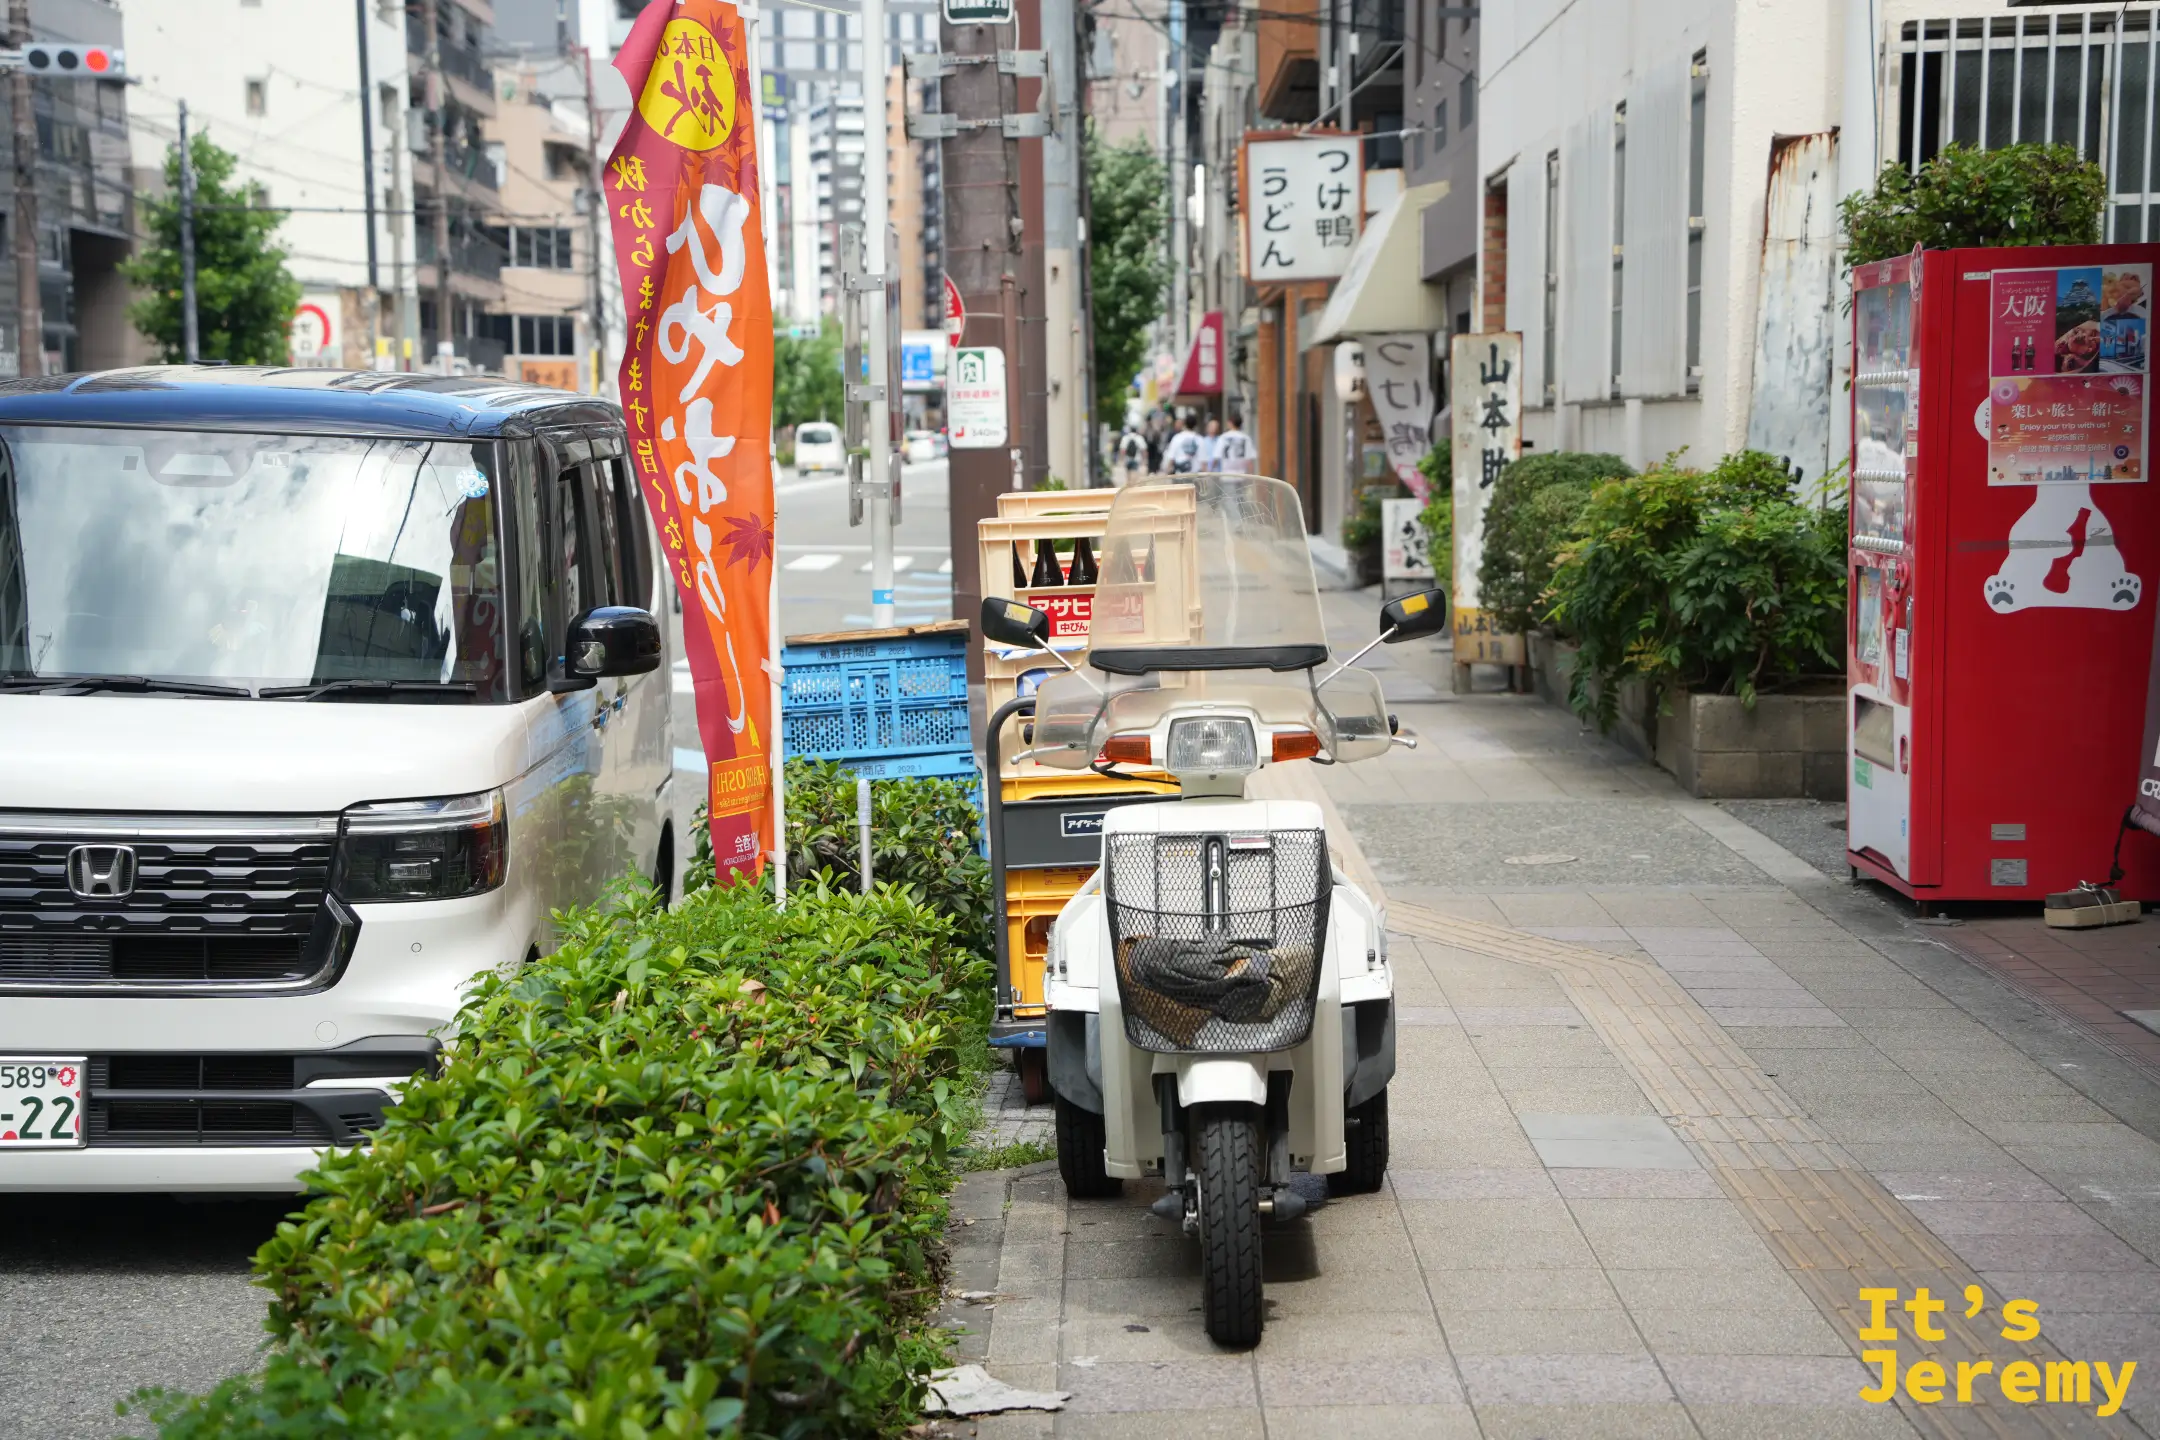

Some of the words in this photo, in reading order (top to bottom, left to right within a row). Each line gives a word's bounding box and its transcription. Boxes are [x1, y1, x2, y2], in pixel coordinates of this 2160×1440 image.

[1315, 148, 1356, 249] つけ鴨
[1260, 167, 1295, 270] うどん
[1999, 294, 2048, 319] 大阪
[2011, 402, 2128, 419] 楽しい旅と一緒に。
[2019, 423, 2041, 432] Enjoy
[2042, 423, 2060, 431] your
[2062, 422, 2076, 430] trip
[2077, 421, 2095, 429] with
[1, 1066, 46, 1089] 589
